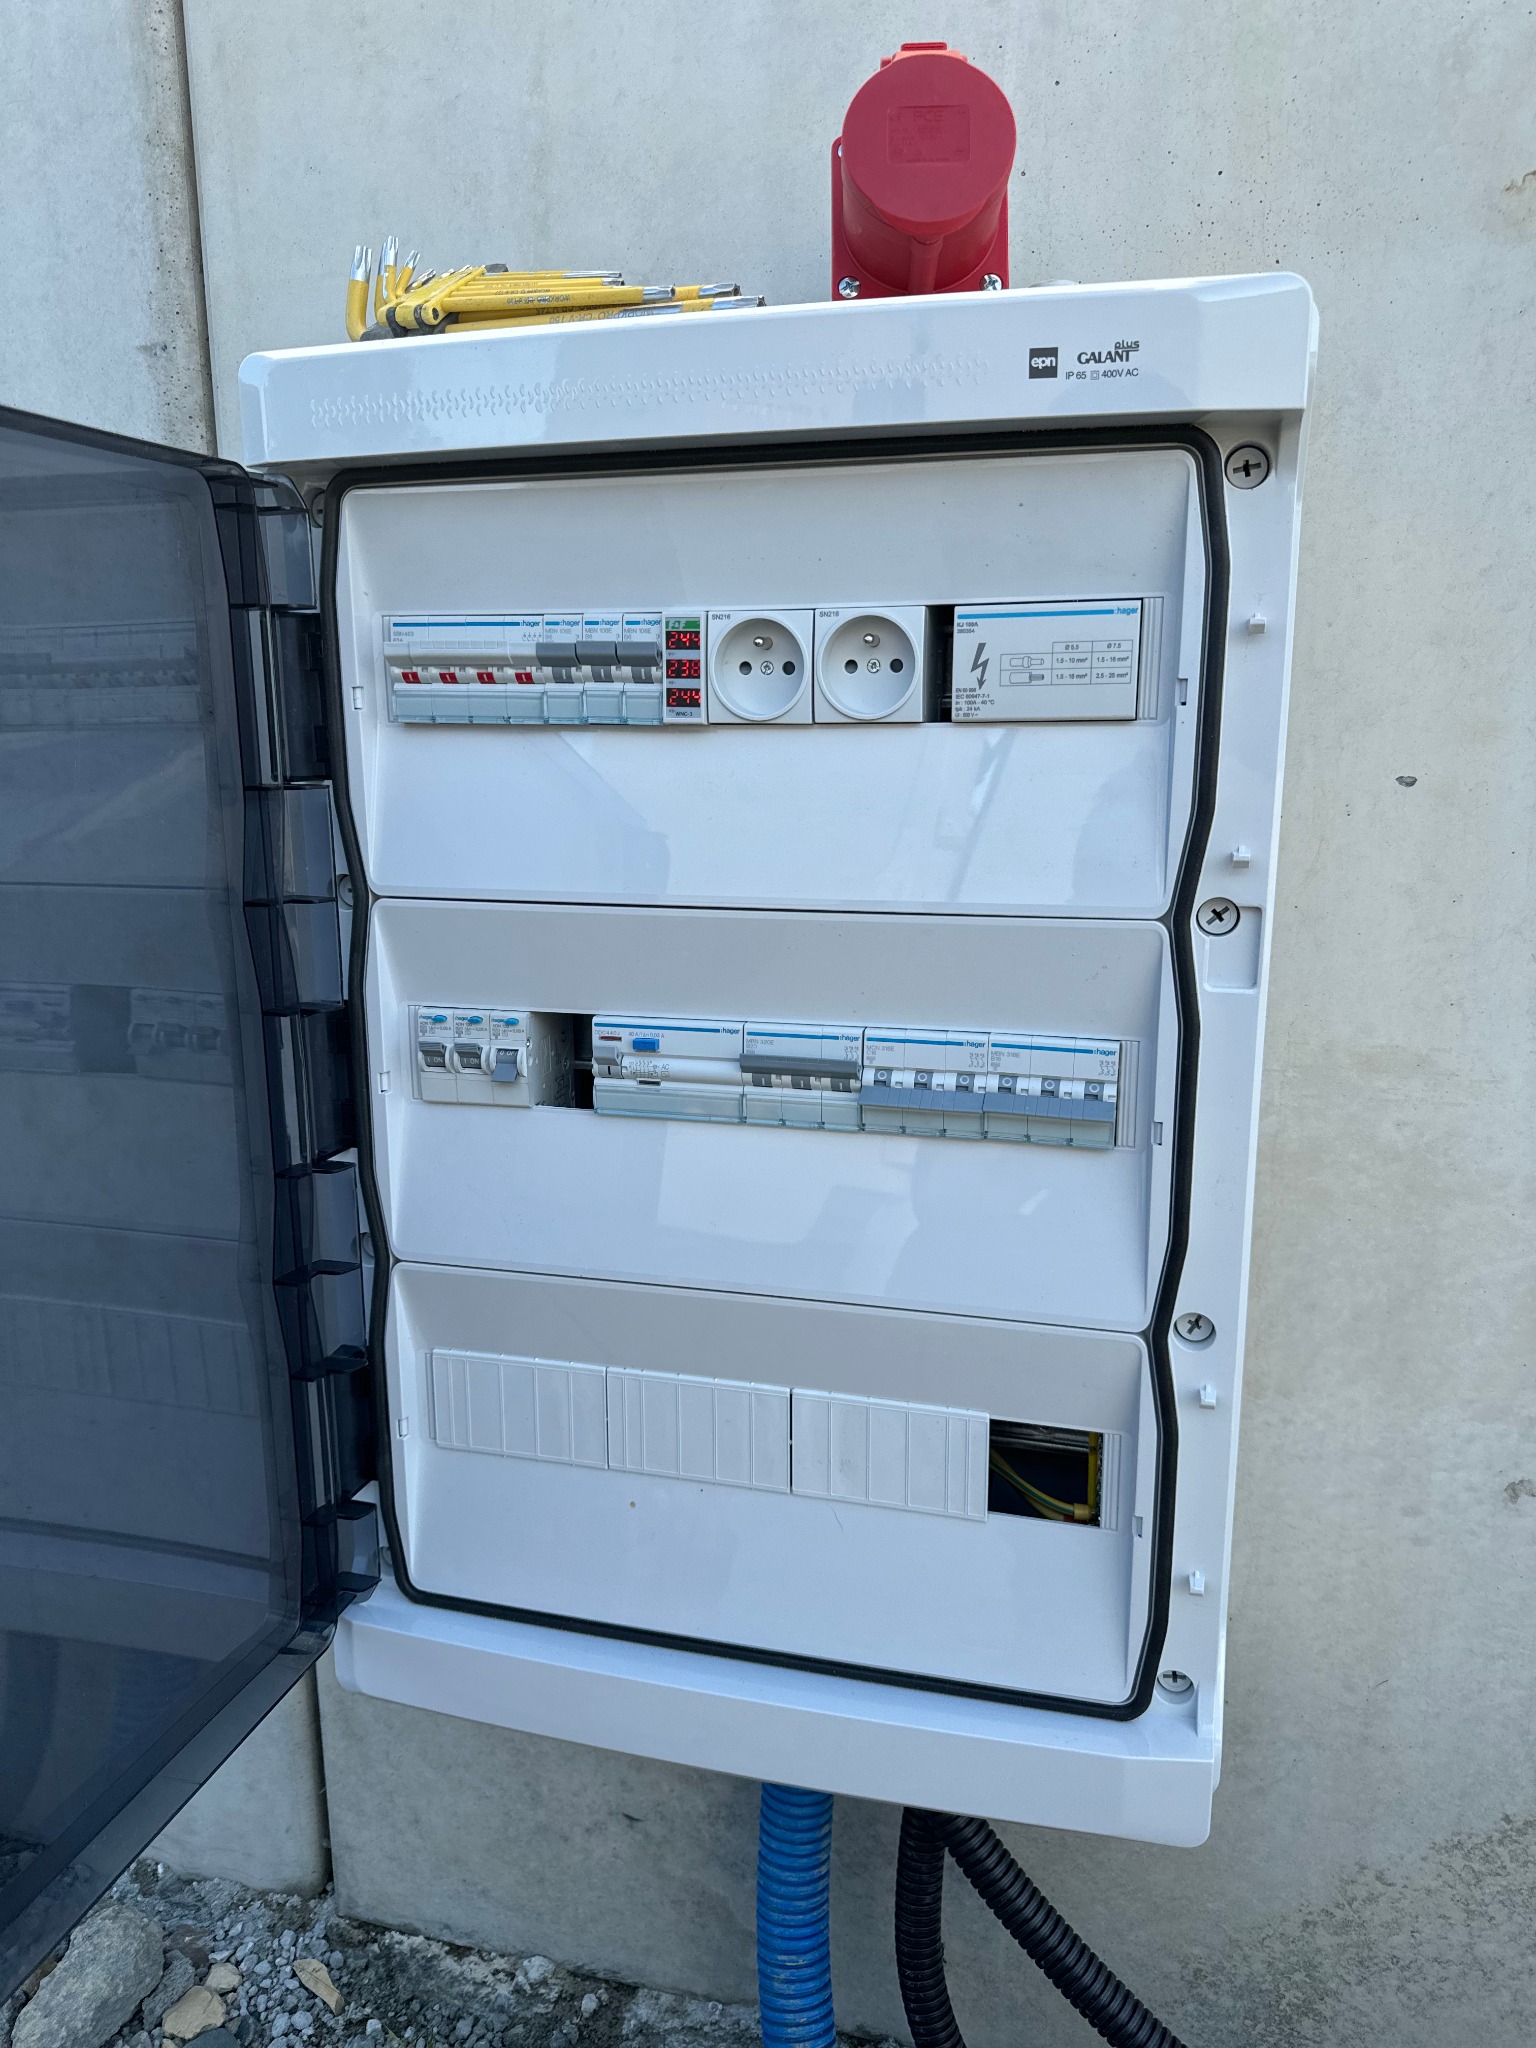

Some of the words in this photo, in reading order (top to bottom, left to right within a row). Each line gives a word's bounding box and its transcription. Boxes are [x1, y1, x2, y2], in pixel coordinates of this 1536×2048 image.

[1114, 340, 1140, 351] plus
[1030, 356, 1056, 370] epn
[1077, 351, 1131, 365] GALANT
[1065, 371, 1075, 380] IP
[1076, 371, 1087, 380] 65
[1101, 368, 1124, 379] 400V
[1125, 368, 1139, 377] AC
[668, 659, 701, 677] 238
[469, 1057, 480, 1065] ON
